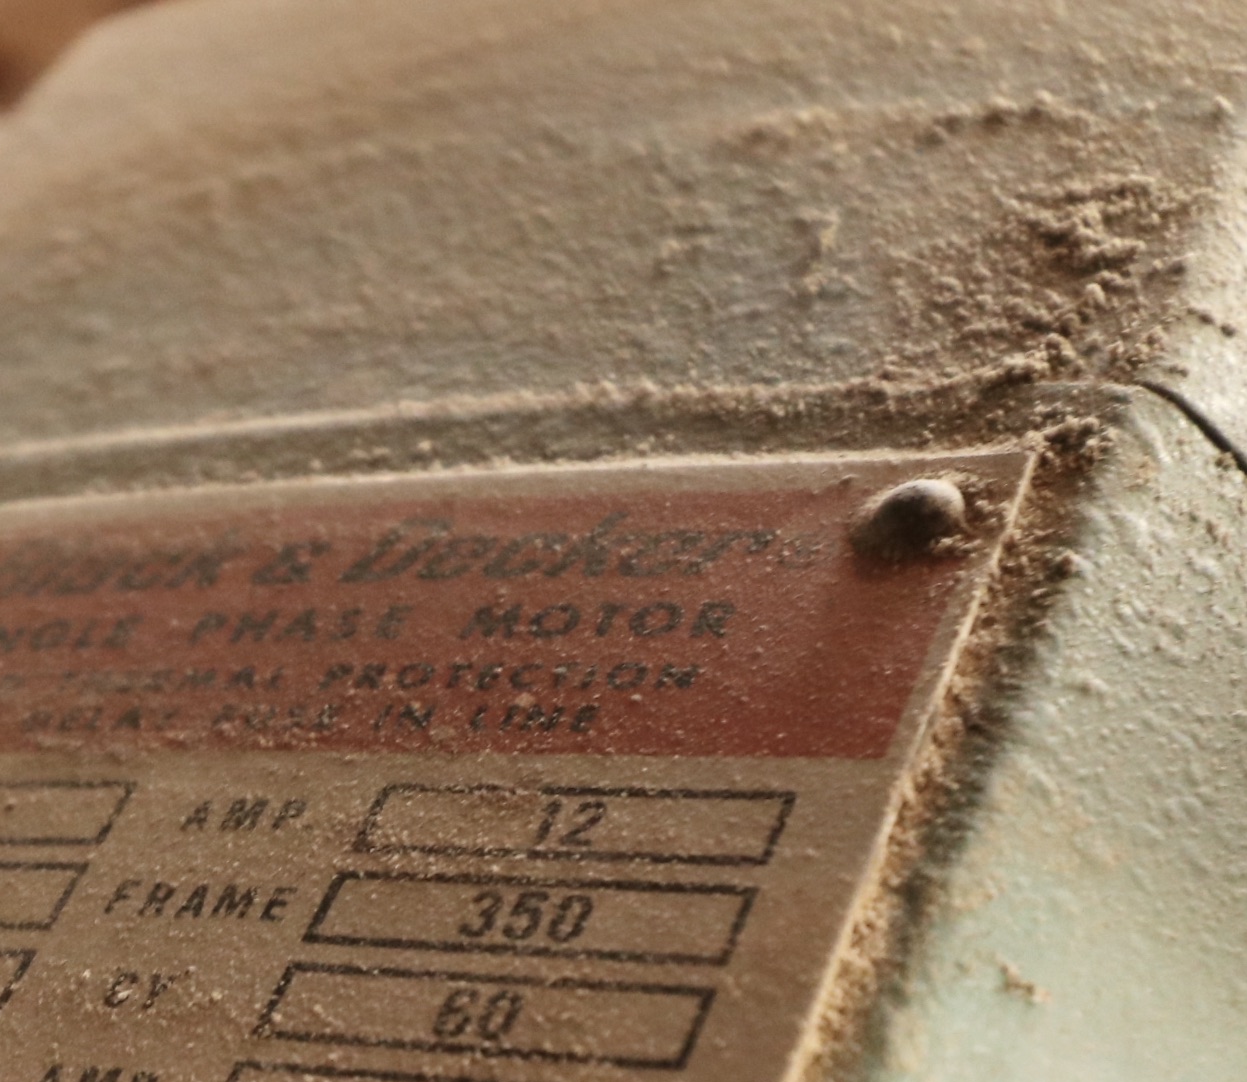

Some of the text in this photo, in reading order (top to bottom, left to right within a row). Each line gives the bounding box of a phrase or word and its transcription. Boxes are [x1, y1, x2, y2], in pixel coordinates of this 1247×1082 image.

[190, 605, 413, 645] PHASE
[459, 600, 738, 642] MOTOR
[318, 661, 702, 692] PROTECTION
[372, 704, 436, 733] IN
[468, 703, 600, 734] LINE
[535, 800, 609, 848] 12
[102, 878, 595, 945] FRAME 350
[432, 986, 525, 1043] 60
